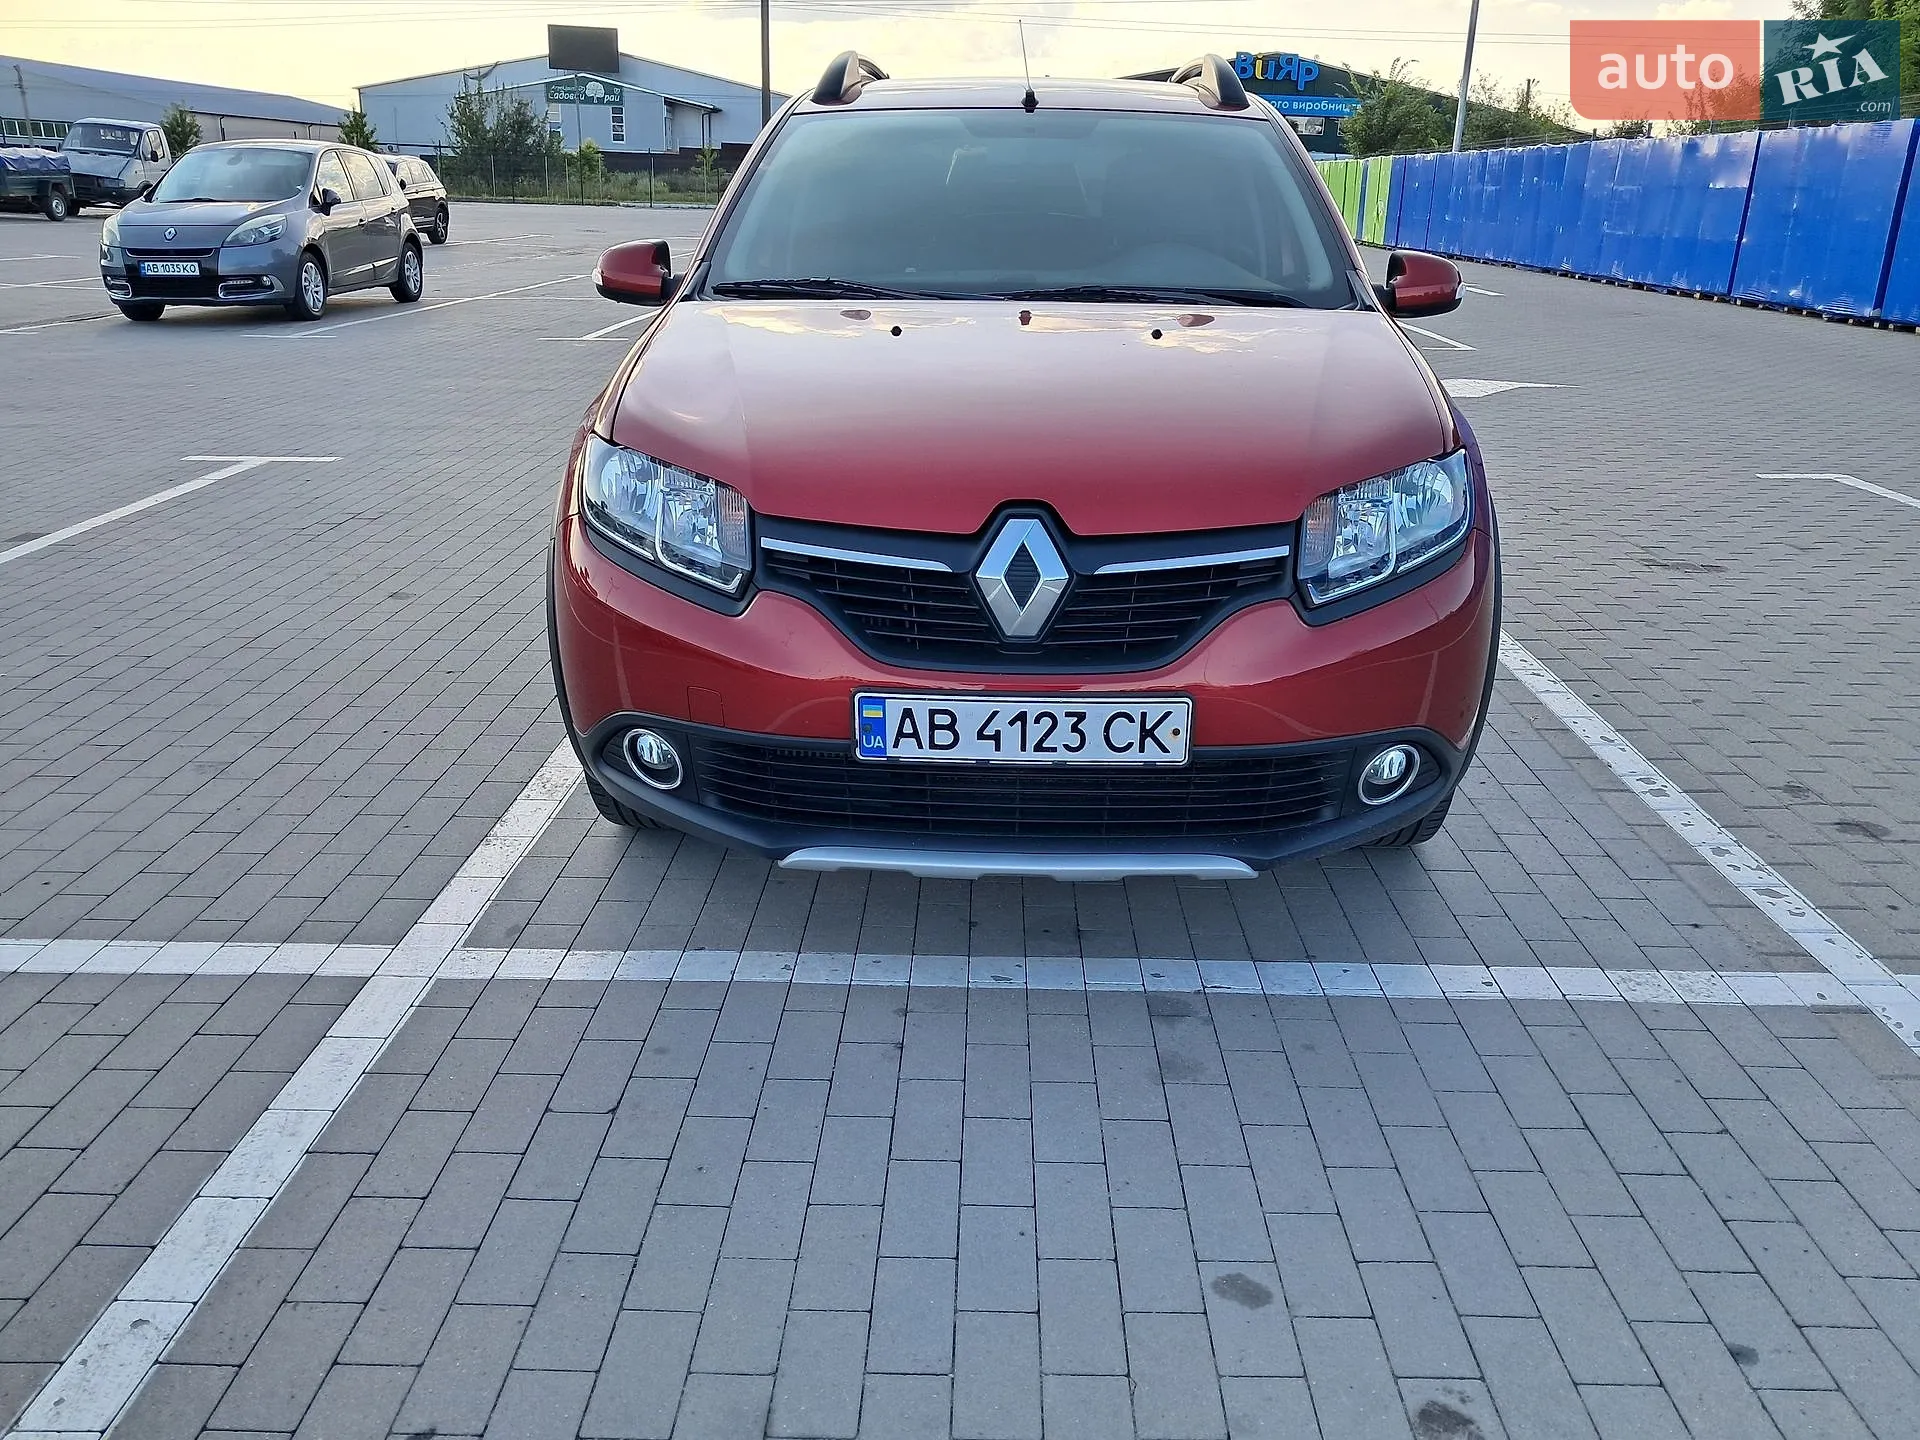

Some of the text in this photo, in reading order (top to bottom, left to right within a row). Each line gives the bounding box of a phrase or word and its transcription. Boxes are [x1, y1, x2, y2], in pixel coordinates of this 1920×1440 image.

[1292, 100, 1361, 112] виробниц
[146, 263, 196, 273] AB 1035 KO
[892, 707, 1174, 754] AB 4123 CK
[862, 735, 885, 749] UA
